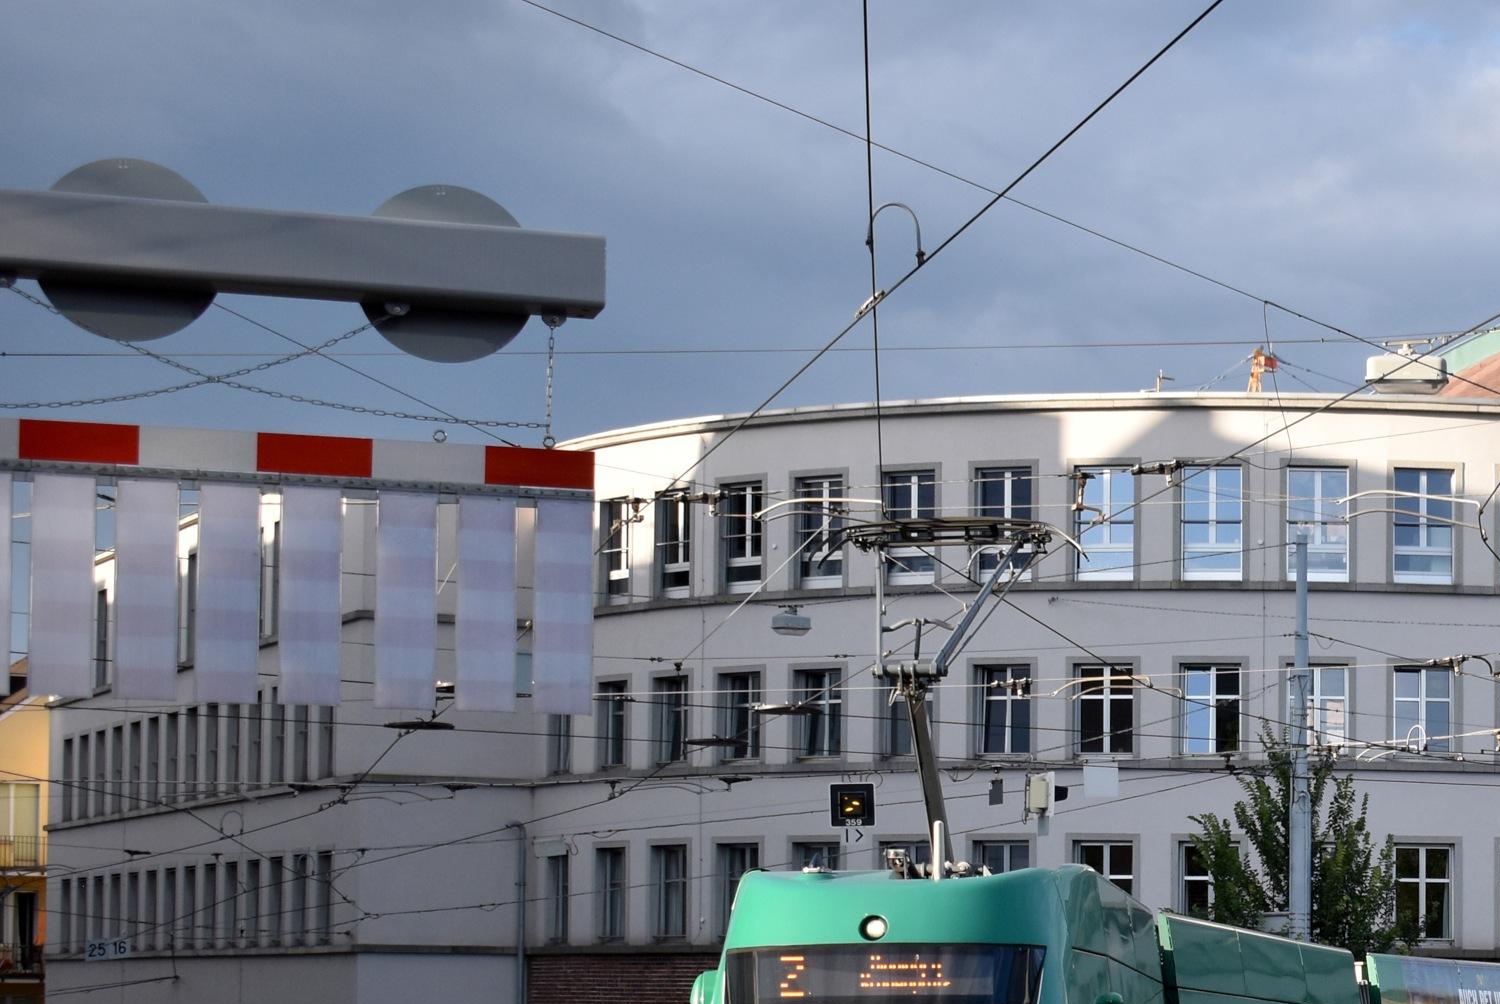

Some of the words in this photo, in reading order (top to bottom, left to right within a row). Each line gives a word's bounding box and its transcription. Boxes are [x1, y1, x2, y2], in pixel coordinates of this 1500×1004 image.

[845, 818, 863, 826] 359
[88, 942, 106, 957] 25
[113, 941, 127, 955] 16
[780, 956, 804, 998] 2
